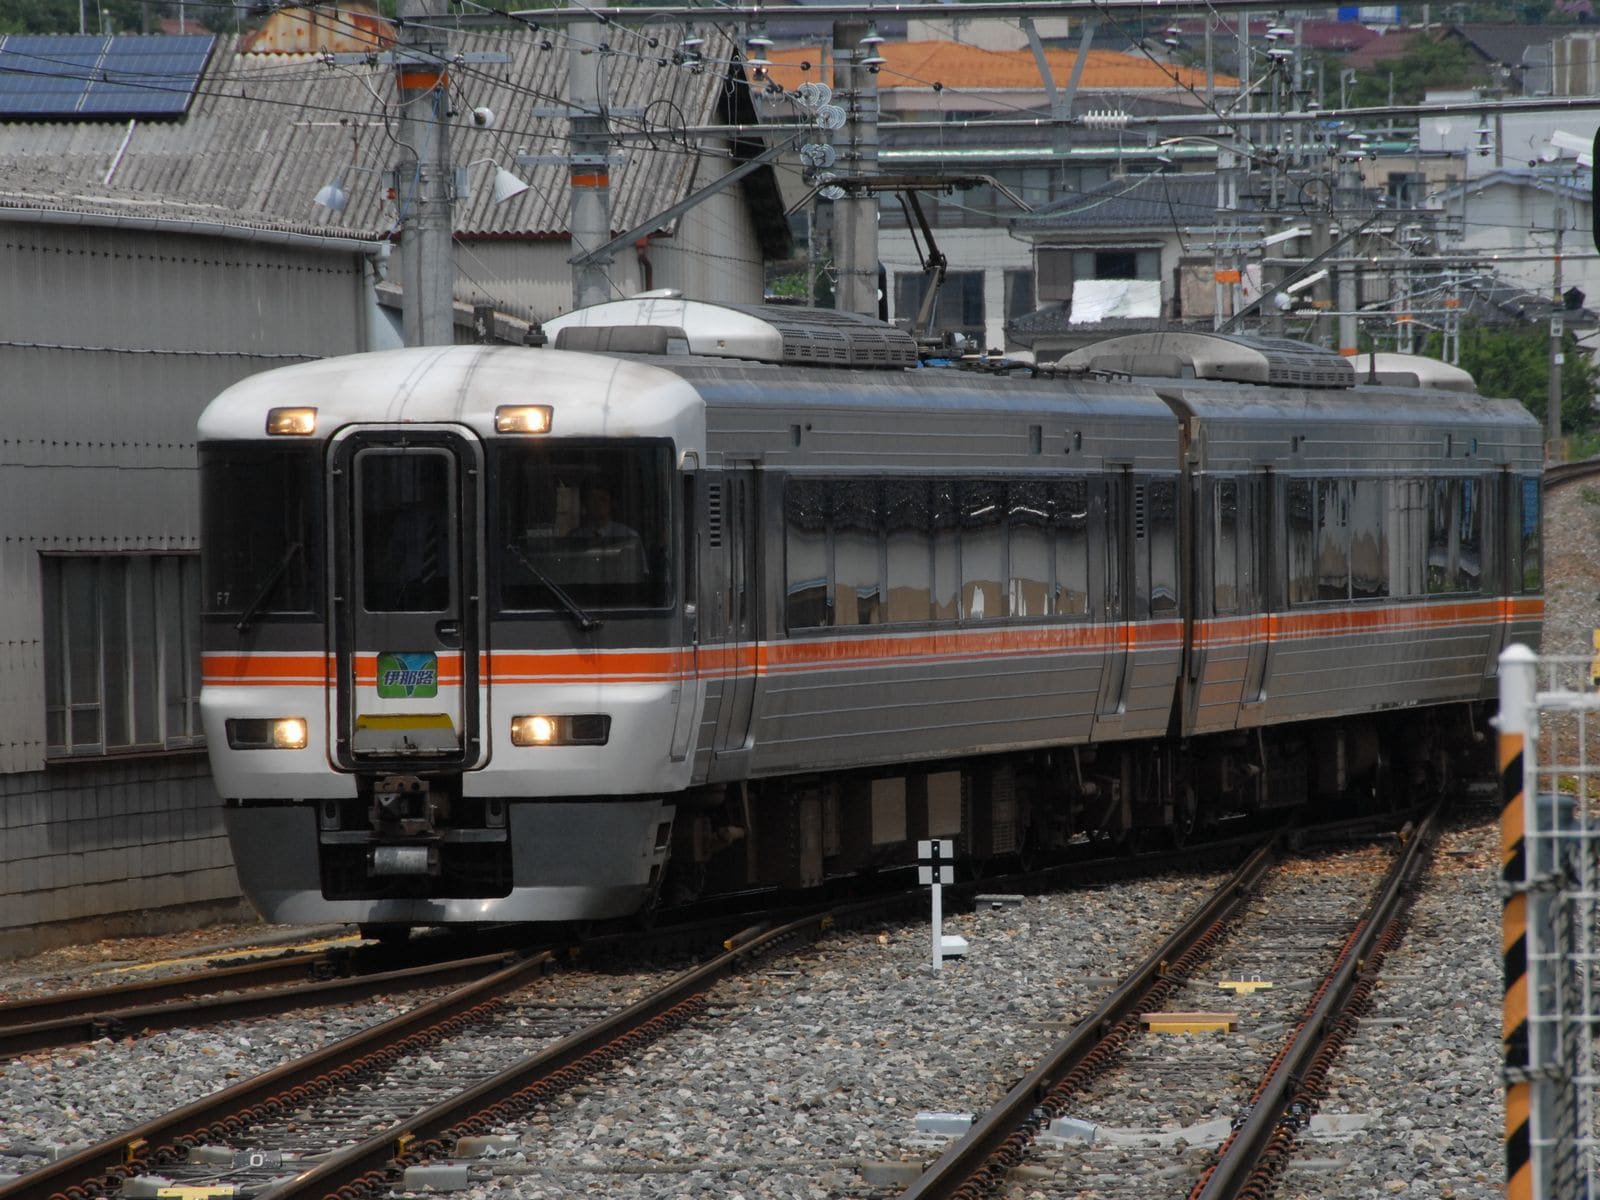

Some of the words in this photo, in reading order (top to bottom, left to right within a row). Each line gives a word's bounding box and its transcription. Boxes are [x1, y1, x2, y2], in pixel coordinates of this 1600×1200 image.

[216, 591, 230, 606] F7
[384, 670, 434, 686] 伊那路
